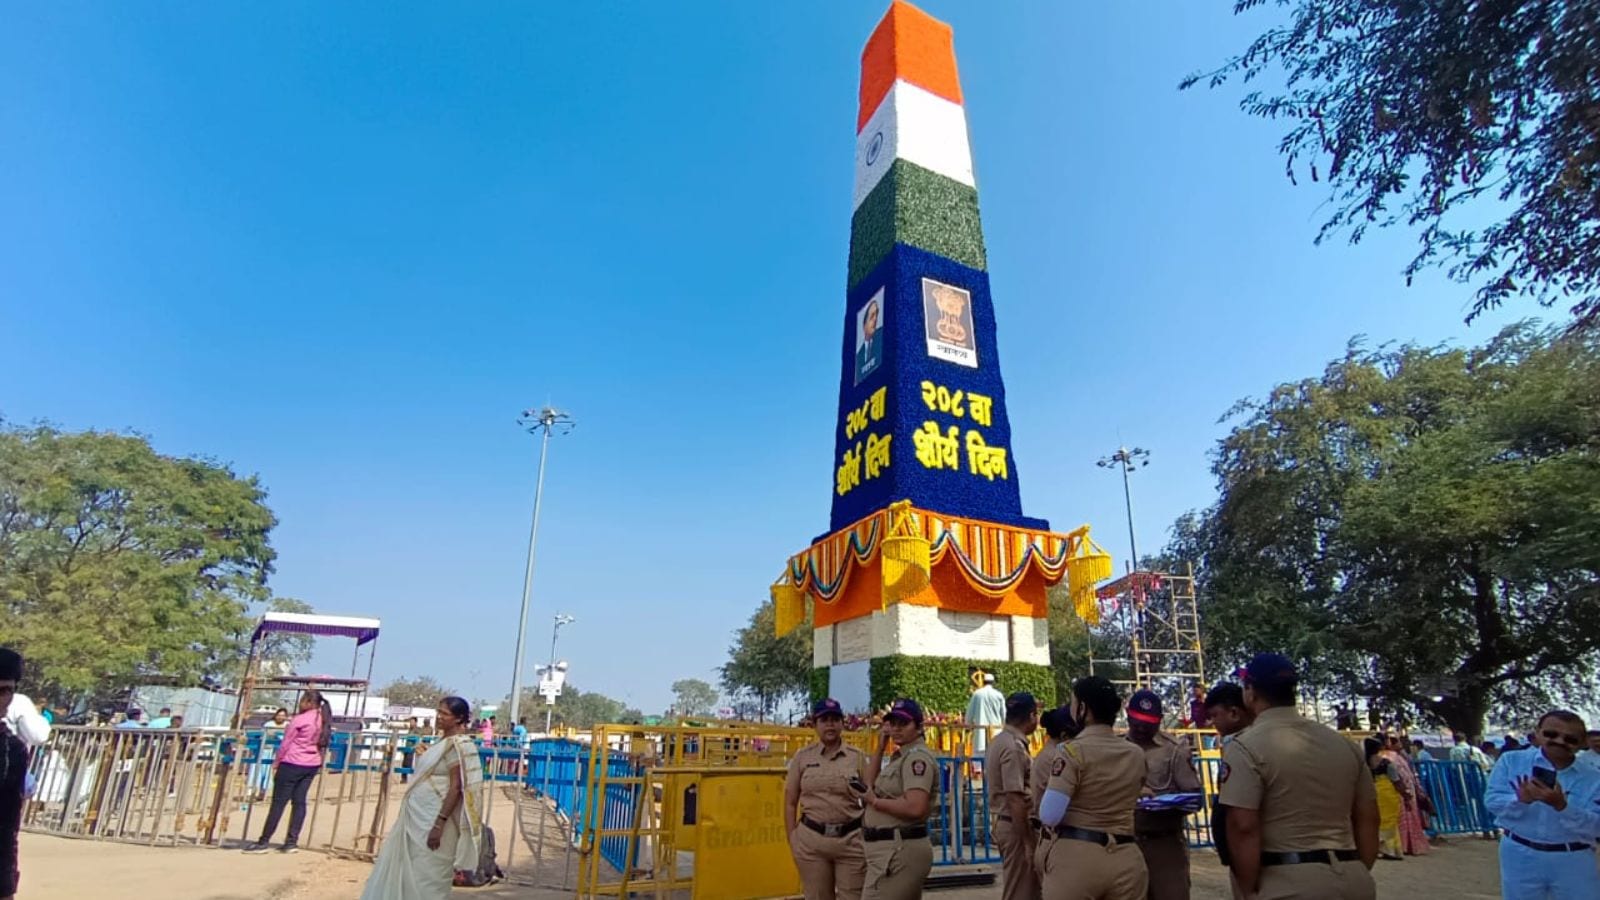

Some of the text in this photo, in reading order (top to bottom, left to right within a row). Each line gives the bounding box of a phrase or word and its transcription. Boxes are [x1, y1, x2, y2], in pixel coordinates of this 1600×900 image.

[845, 386, 888, 439] २०८ वा
[921, 381, 993, 427] २०८ वा
[865, 433, 892, 480] दिन
[965, 430, 1008, 480] दिन
